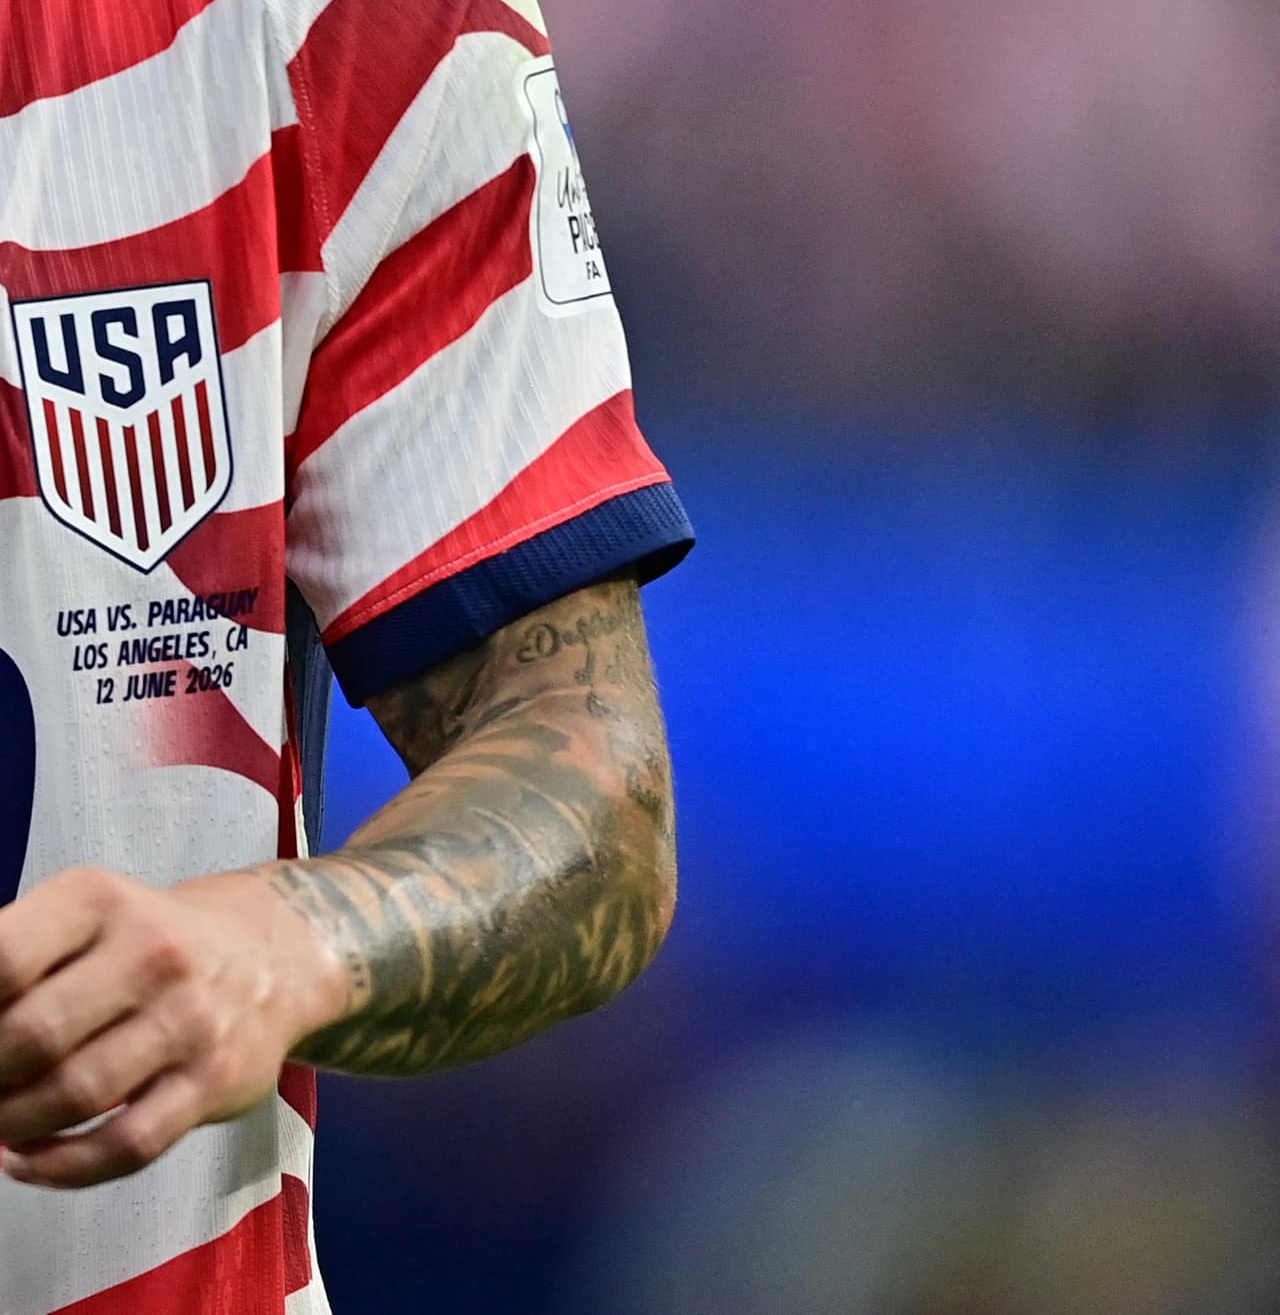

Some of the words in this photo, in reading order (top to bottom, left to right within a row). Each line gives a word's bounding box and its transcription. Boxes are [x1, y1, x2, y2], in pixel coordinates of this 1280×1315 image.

[30, 298, 202, 409] USA
[56, 608, 97, 637] USA
[107, 604, 137, 632] VS.
[147, 588, 259, 627] PARAGUAY
[73, 643, 108, 671] LOS
[117, 631, 216, 667] ANGELES,
[226, 625, 249, 652] CA
[96, 677, 115, 704] 12
[122, 670, 178, 702] JUNE
[185, 662, 235, 695] 2026
